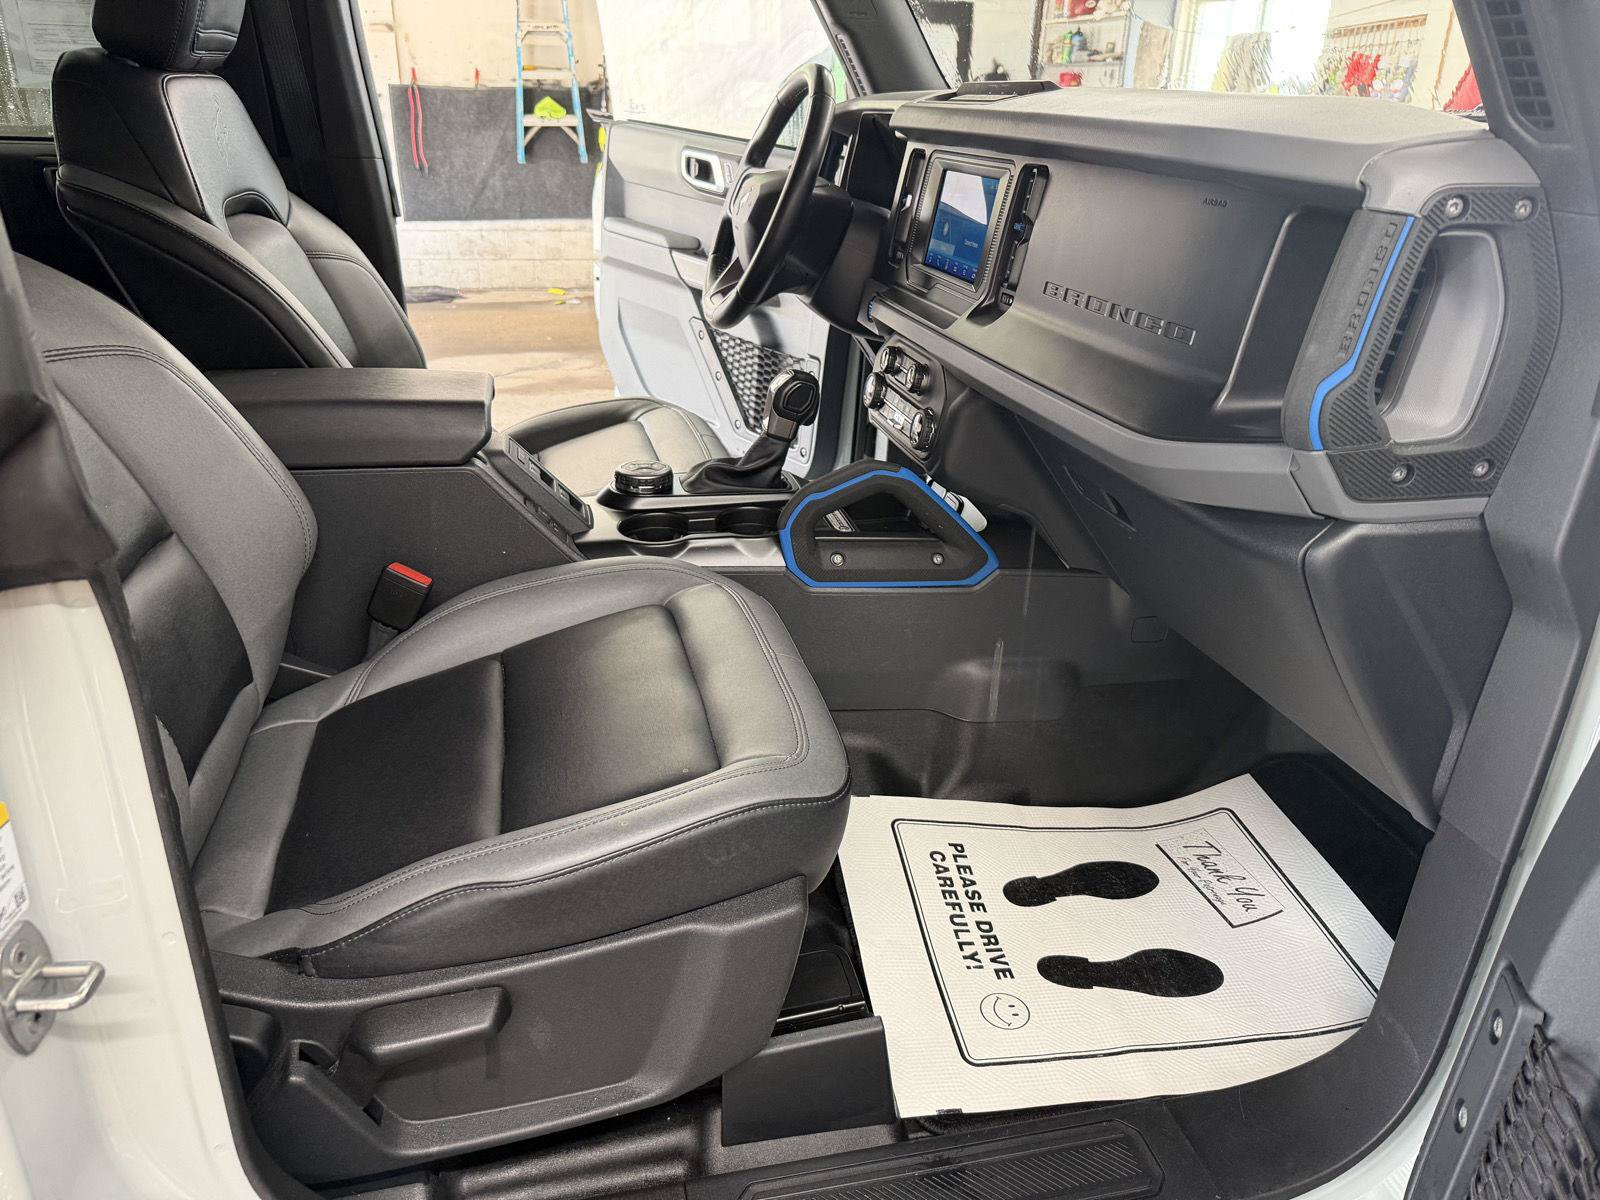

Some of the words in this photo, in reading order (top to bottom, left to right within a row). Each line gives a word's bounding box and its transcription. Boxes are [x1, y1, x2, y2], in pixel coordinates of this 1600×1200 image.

[1042, 280, 1197, 346] BRONCO
[1339, 221, 1398, 355] BRONCO
[929, 850, 984, 970] CAREFULLY!
[948, 842, 988, 913] PLEASE
[975, 920, 1015, 980] DRIVE
[1182, 840, 1247, 885] Thank
[1226, 886, 1265, 912] You
